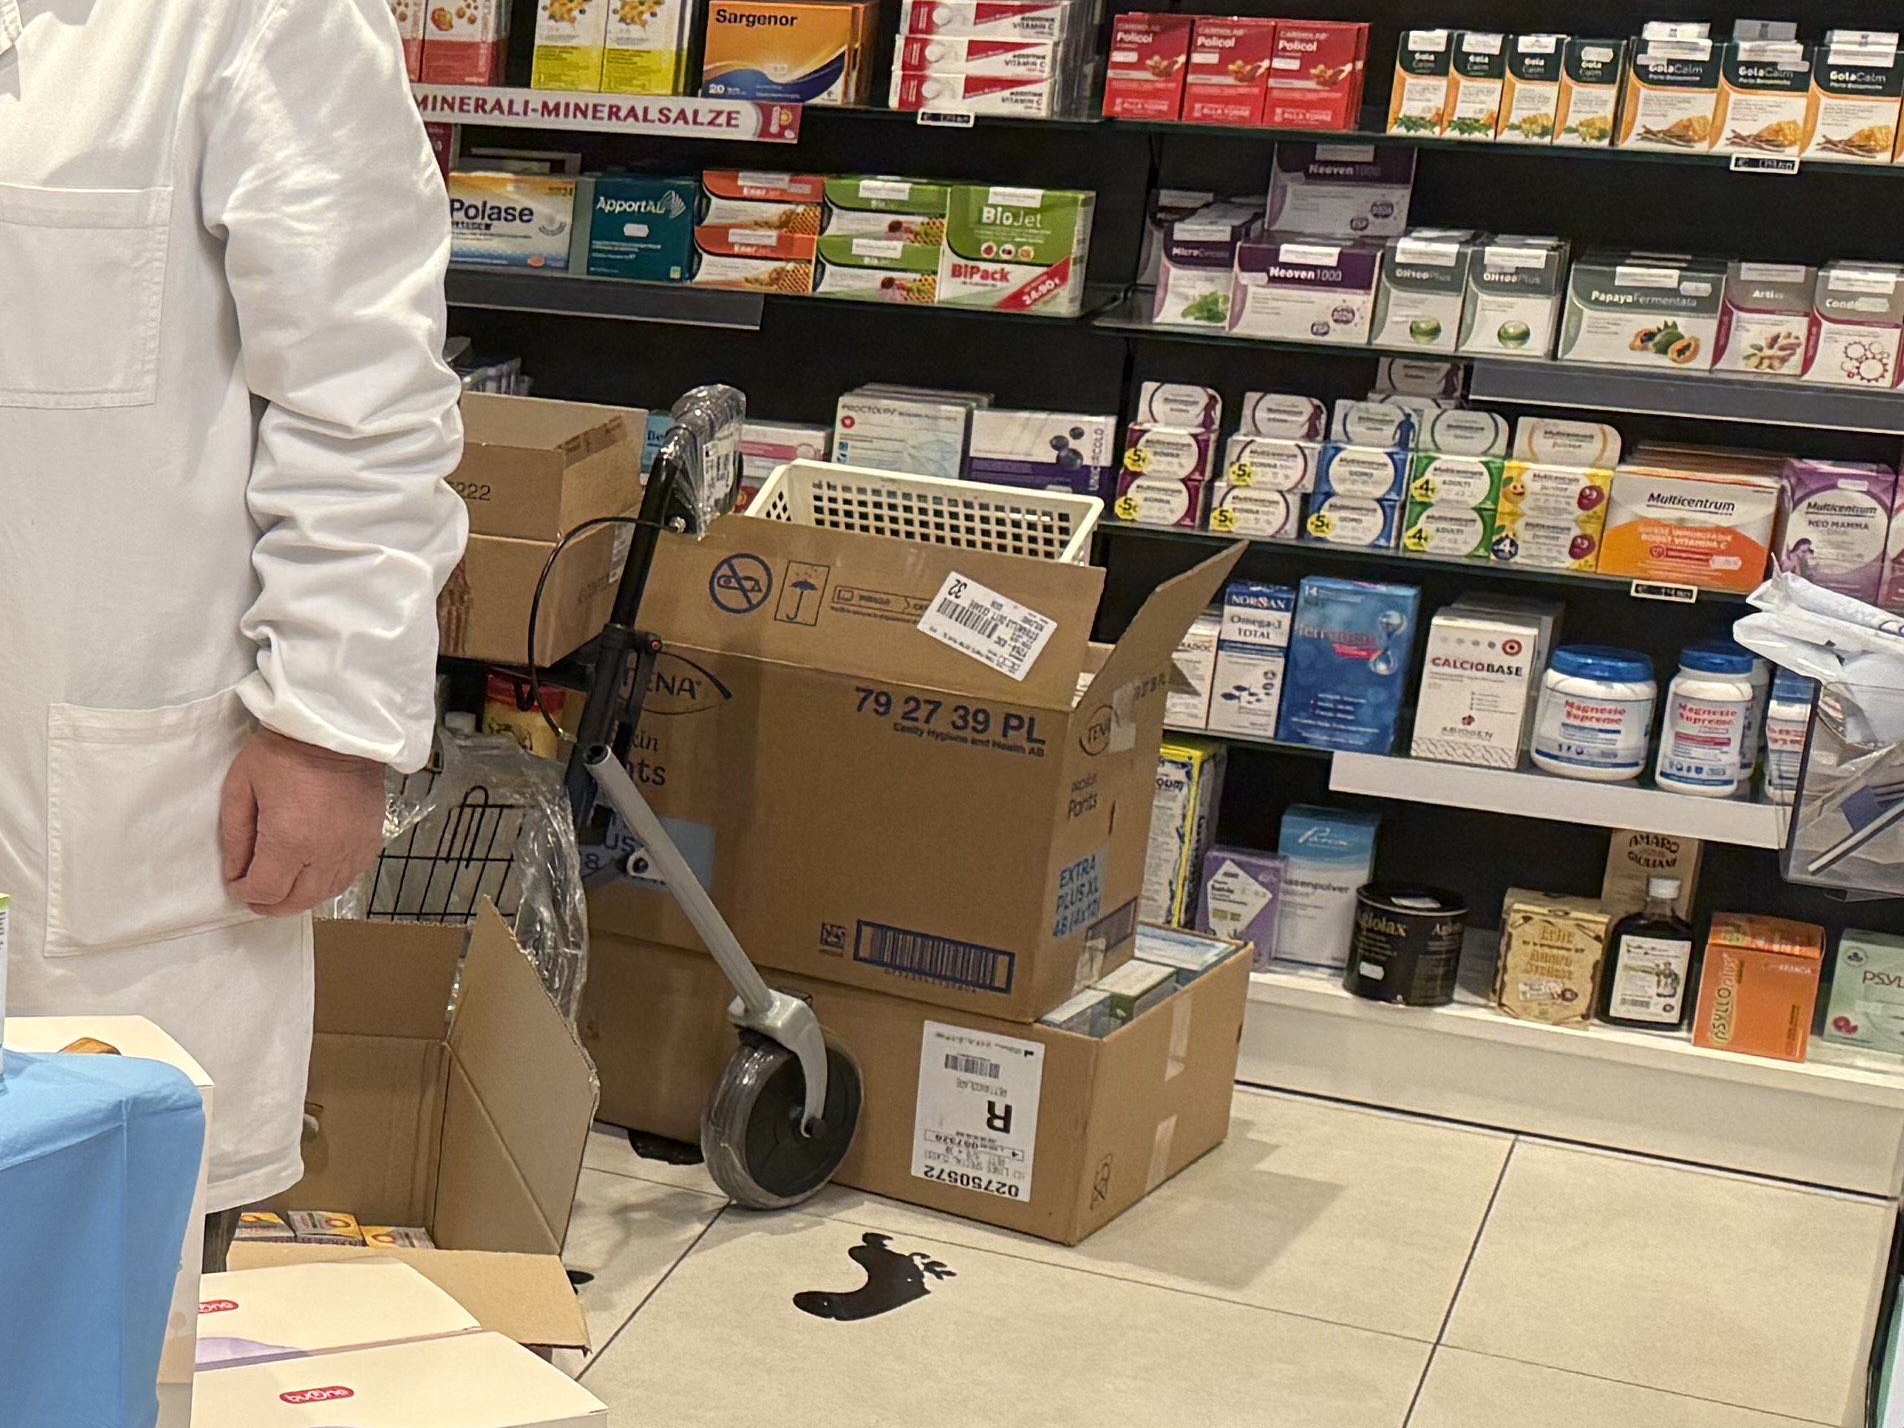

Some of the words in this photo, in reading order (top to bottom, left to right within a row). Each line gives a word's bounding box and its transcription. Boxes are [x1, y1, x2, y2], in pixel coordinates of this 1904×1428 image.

[715, 8, 797, 28] Sargenor
[449, 198, 534, 226] Polase
[1647, 491, 1736, 514] Multicentrum
[1431, 655, 1523, 677] CALCIOBASE
[853, 687, 894, 719] 79
[901, 695, 943, 727] 27
[950, 701, 993, 734] 39
[1001, 712, 1046, 744] PL
